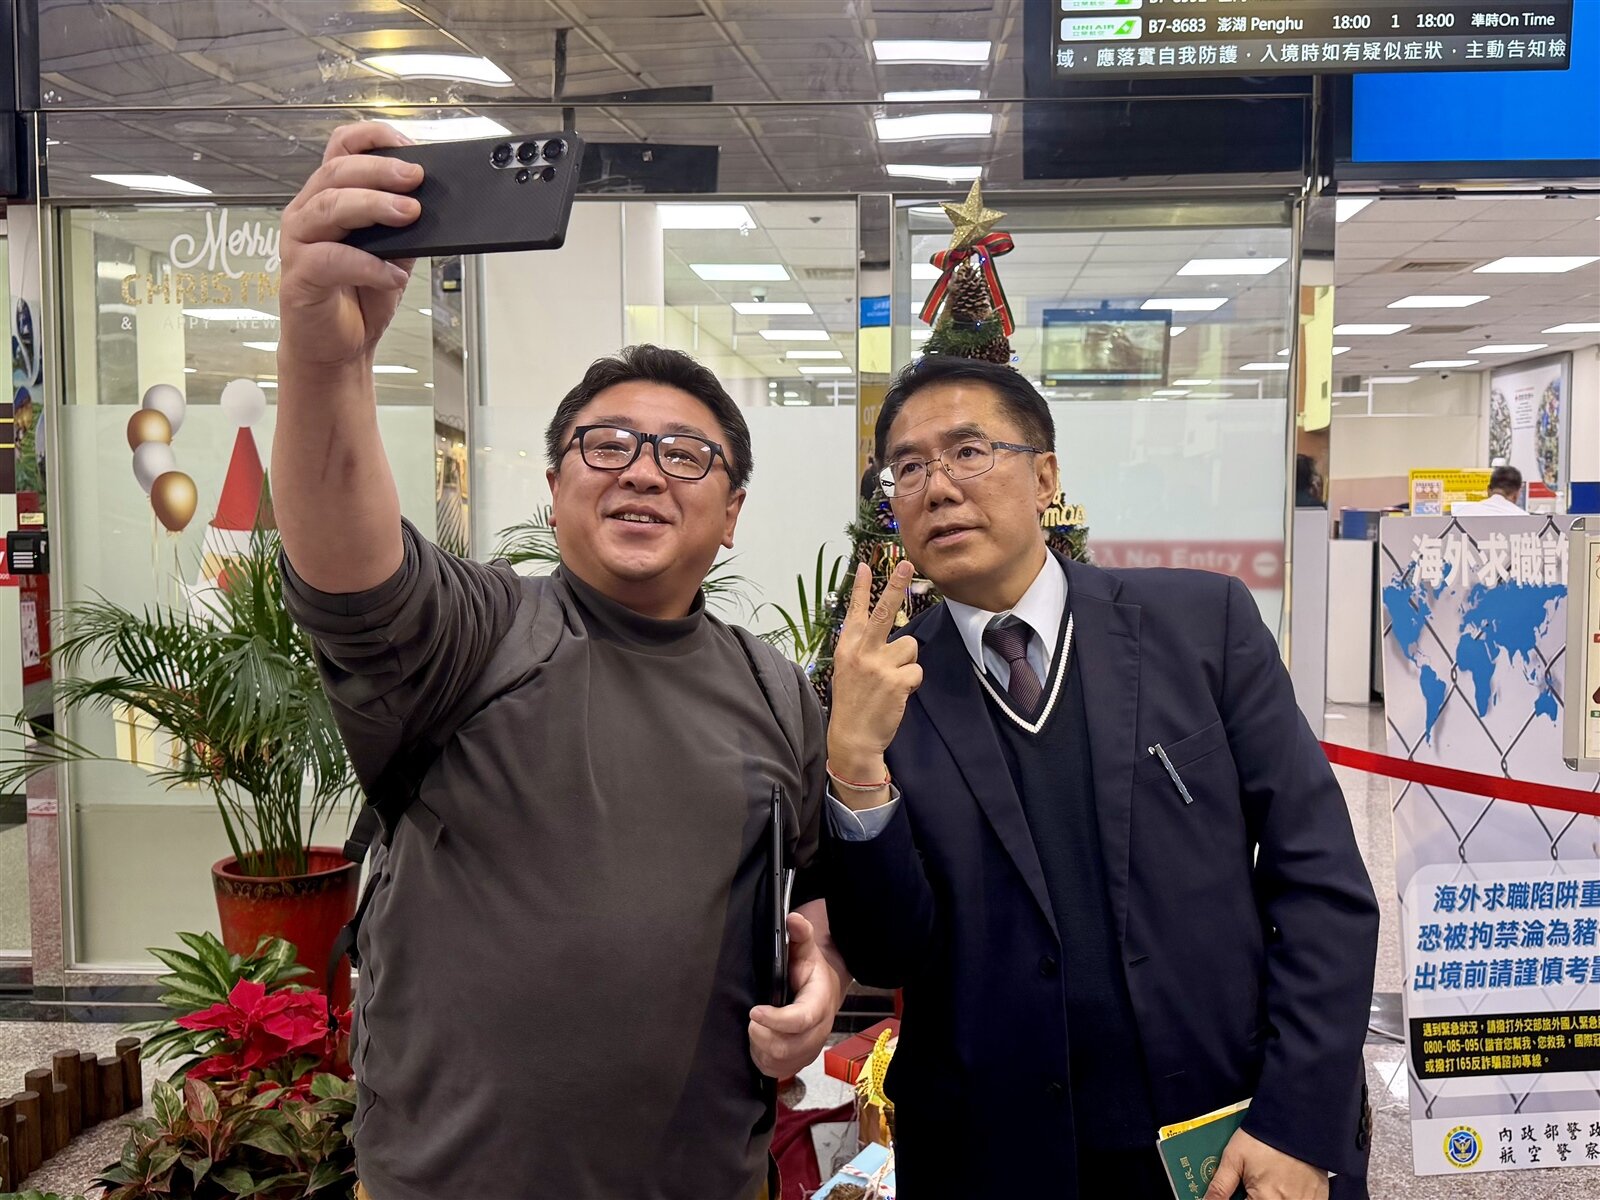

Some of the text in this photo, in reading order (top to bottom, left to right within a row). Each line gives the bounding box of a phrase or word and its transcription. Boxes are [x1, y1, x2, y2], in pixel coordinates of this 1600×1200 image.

[1149, 18, 1207, 33] B7-8683
[1217, 16, 1248, 33] 澎湖
[1250, 16, 1304, 34] Penghu
[1332, 15, 1371, 30] 18:00
[1391, 14, 1400, 29] 1
[1416, 14, 1455, 28] 18:00
[1521, 12, 1556, 27] Time
[170, 208, 281, 279] Merry
[120, 315, 277, 331] & APPY NEW
[1171, 547, 1243, 572] Entry
[1433, 880, 1600, 912] 海外求職陷阱重
[1417, 918, 1600, 951] 恐被拘禁淪為豬
[1499, 1141, 1600, 1165] 航空警察
